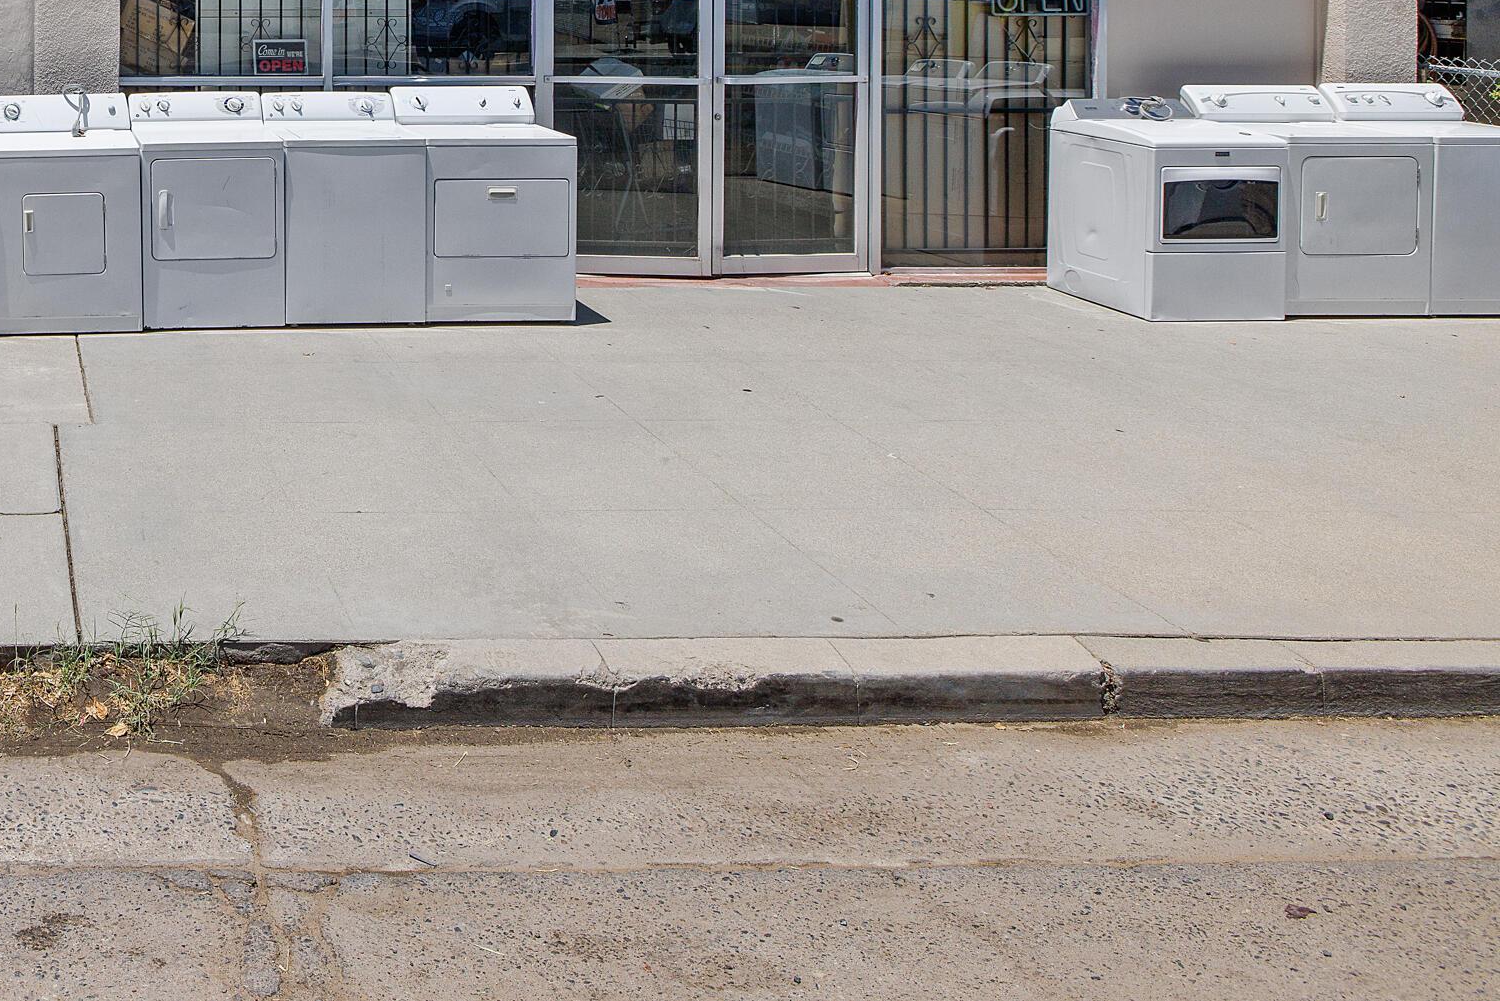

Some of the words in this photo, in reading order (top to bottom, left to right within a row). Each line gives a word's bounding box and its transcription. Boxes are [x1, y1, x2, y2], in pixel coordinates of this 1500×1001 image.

[257, 44, 278, 56] Come
[278, 47, 285, 56] in
[259, 59, 304, 72] OPEN
